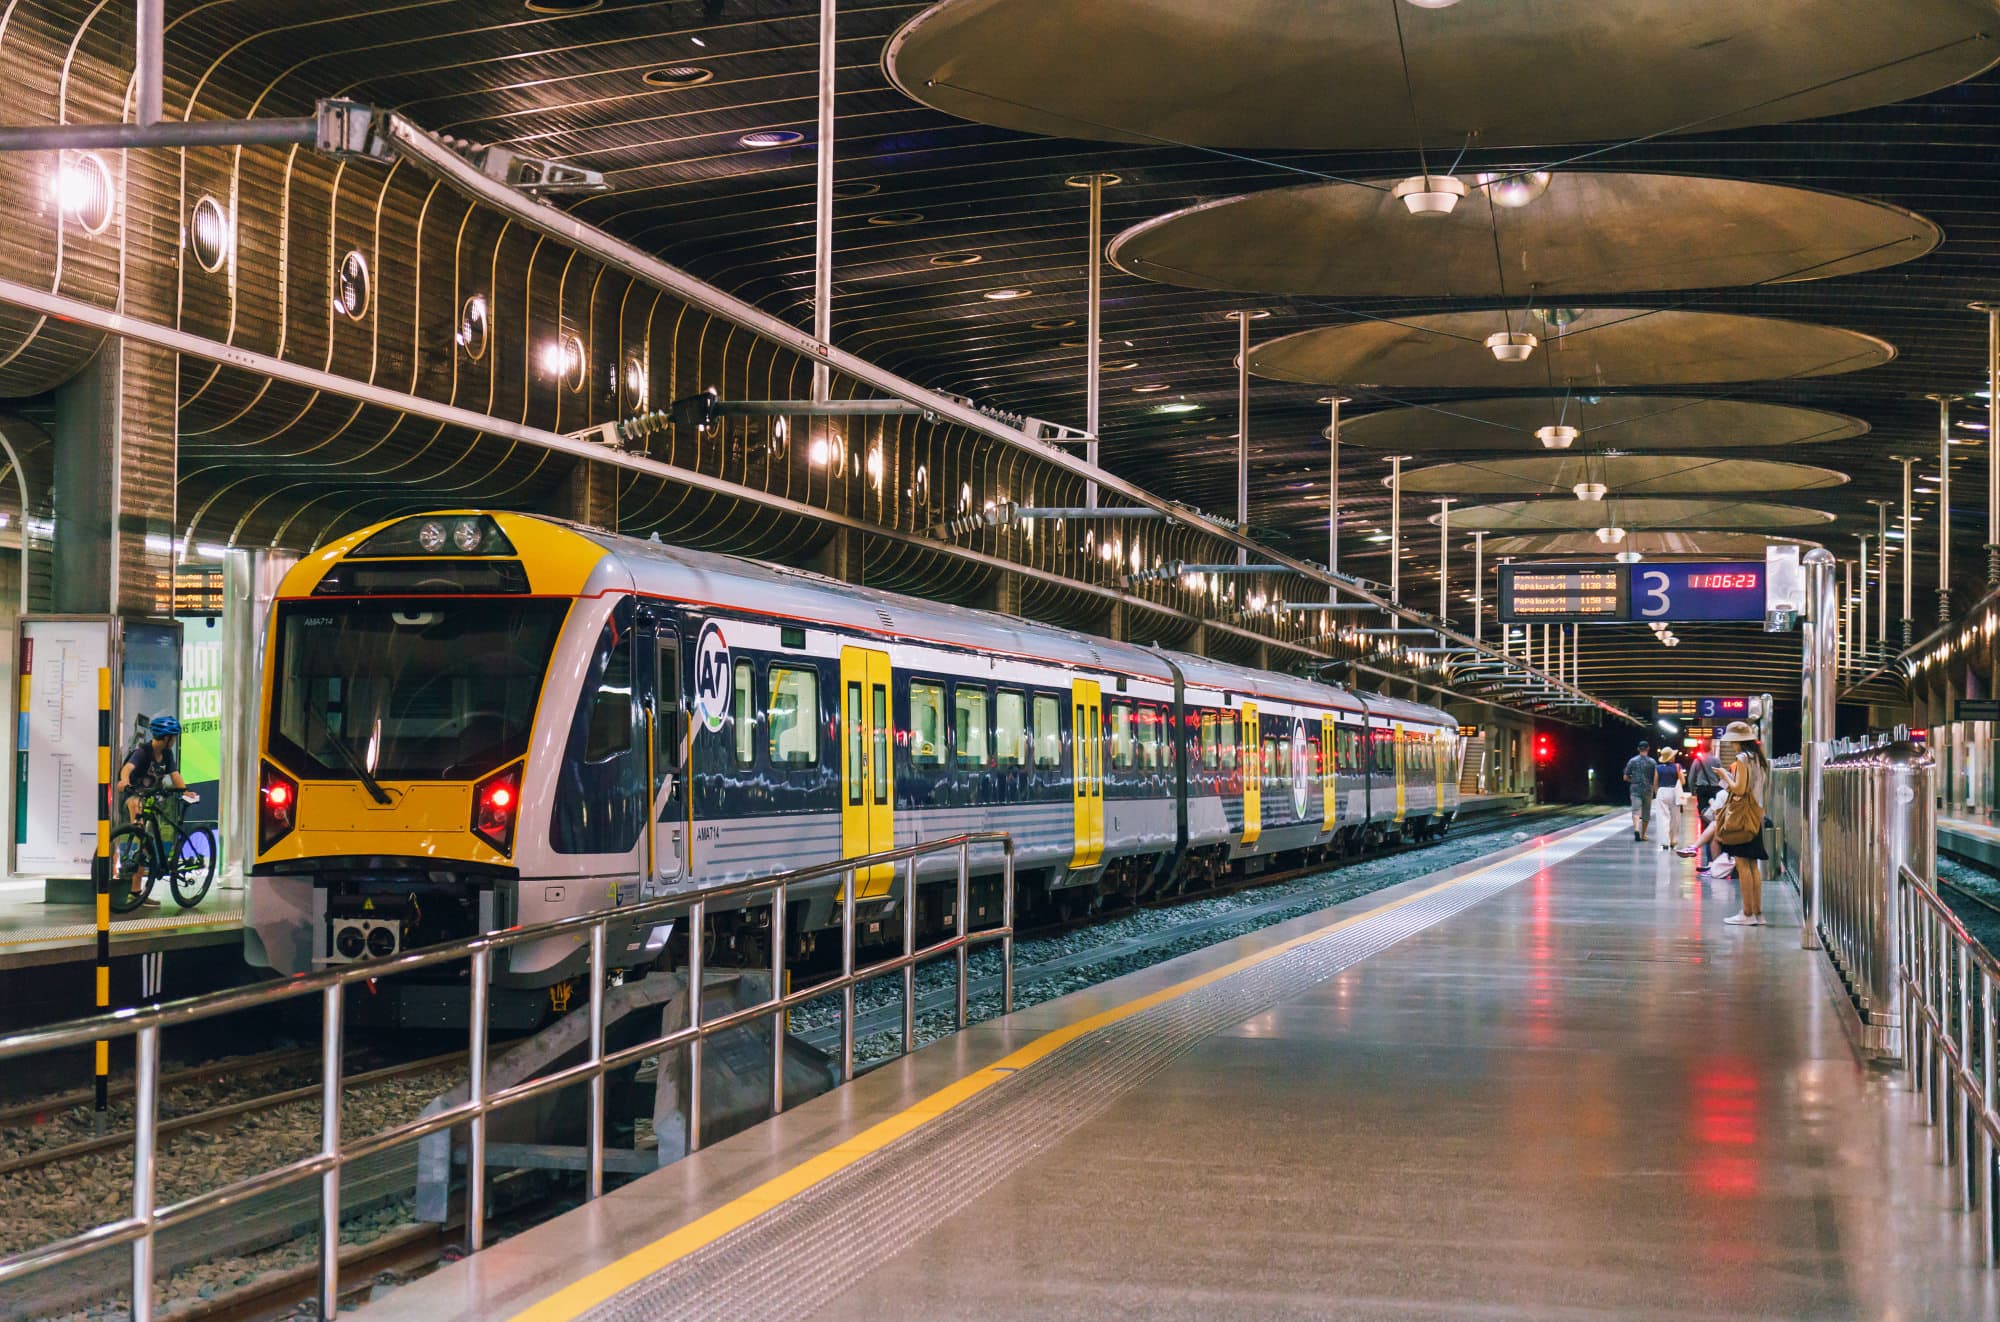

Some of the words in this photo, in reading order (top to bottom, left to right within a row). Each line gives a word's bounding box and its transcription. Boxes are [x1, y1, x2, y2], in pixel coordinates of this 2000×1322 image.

[1693, 574, 1757, 589] 11:06:23
[1641, 571, 1671, 617] 3
[304, 617, 334, 626] AMA714
[700, 649, 729, 699] AT
[183, 690, 221, 720] EEKEN
[1703, 700, 1716, 717] 3
[1722, 701, 1744, 709] 11:06
[1715, 727, 1724, 736] 3
[696, 825, 720, 841] AMA714
